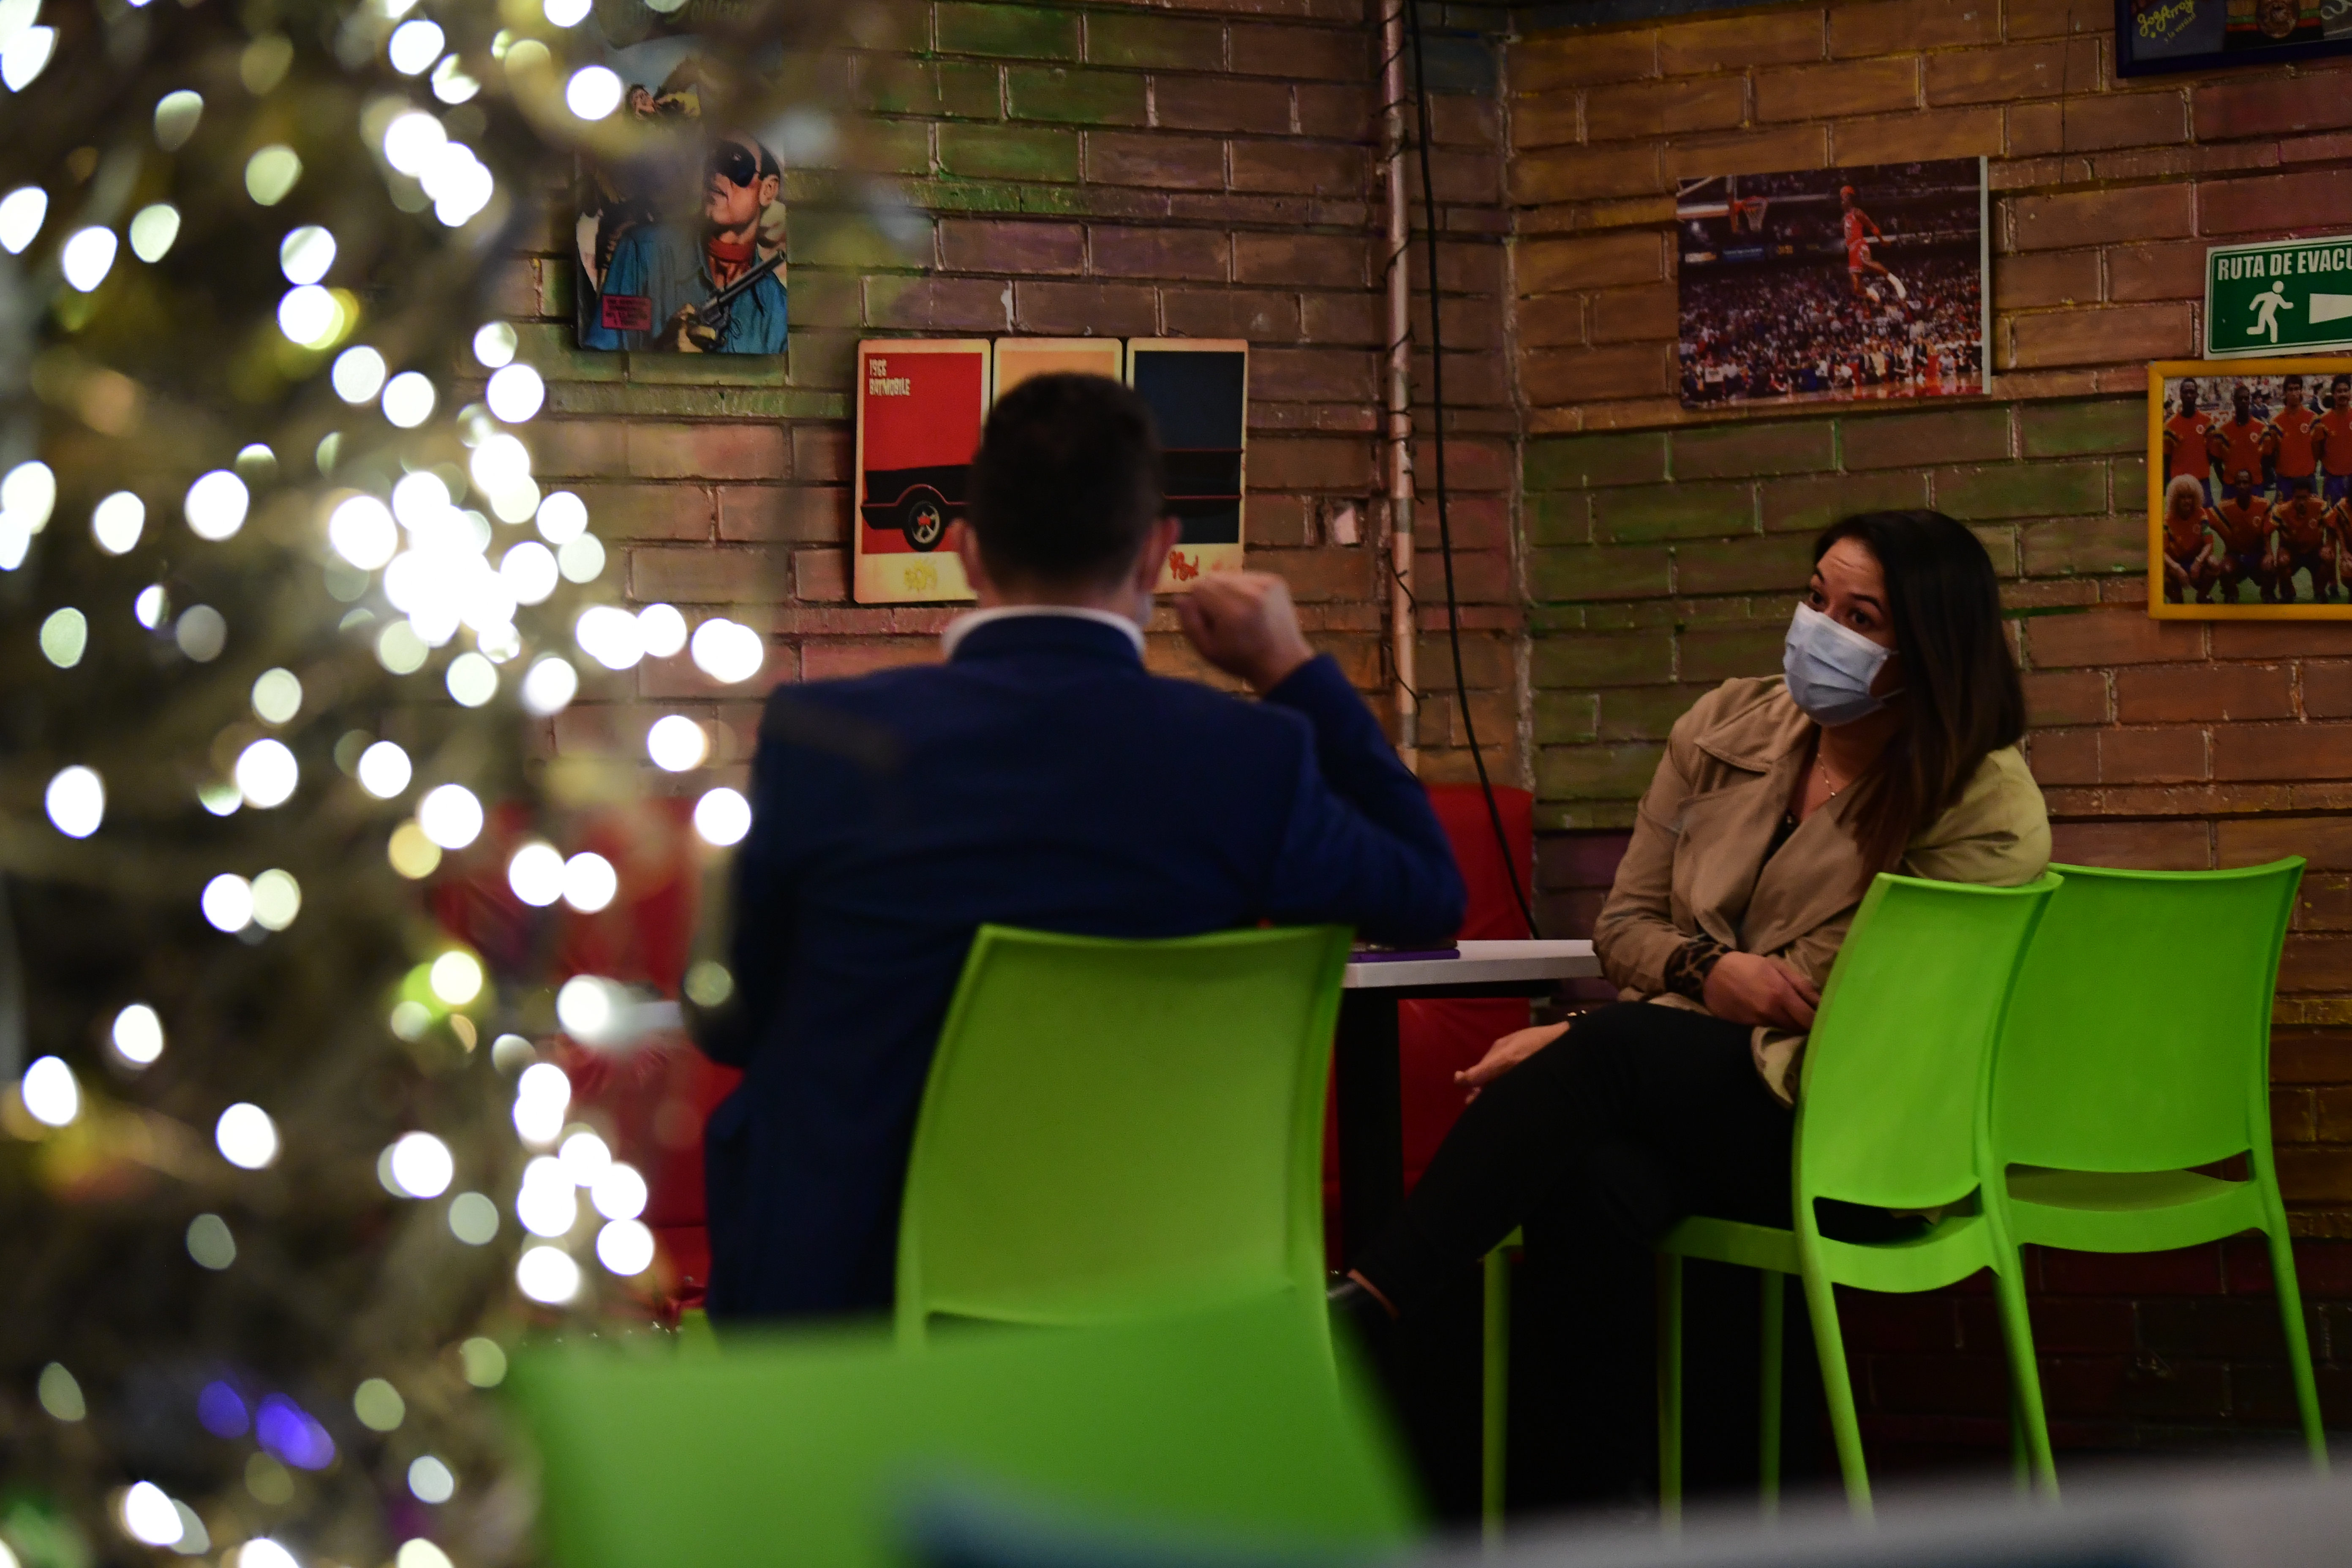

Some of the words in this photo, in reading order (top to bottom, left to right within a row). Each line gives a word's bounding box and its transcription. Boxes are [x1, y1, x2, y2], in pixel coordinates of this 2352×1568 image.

[2217, 255, 2265, 281] RUTA
[2270, 252, 2293, 276] DE
[869, 377, 910, 396] BATMOBILE
